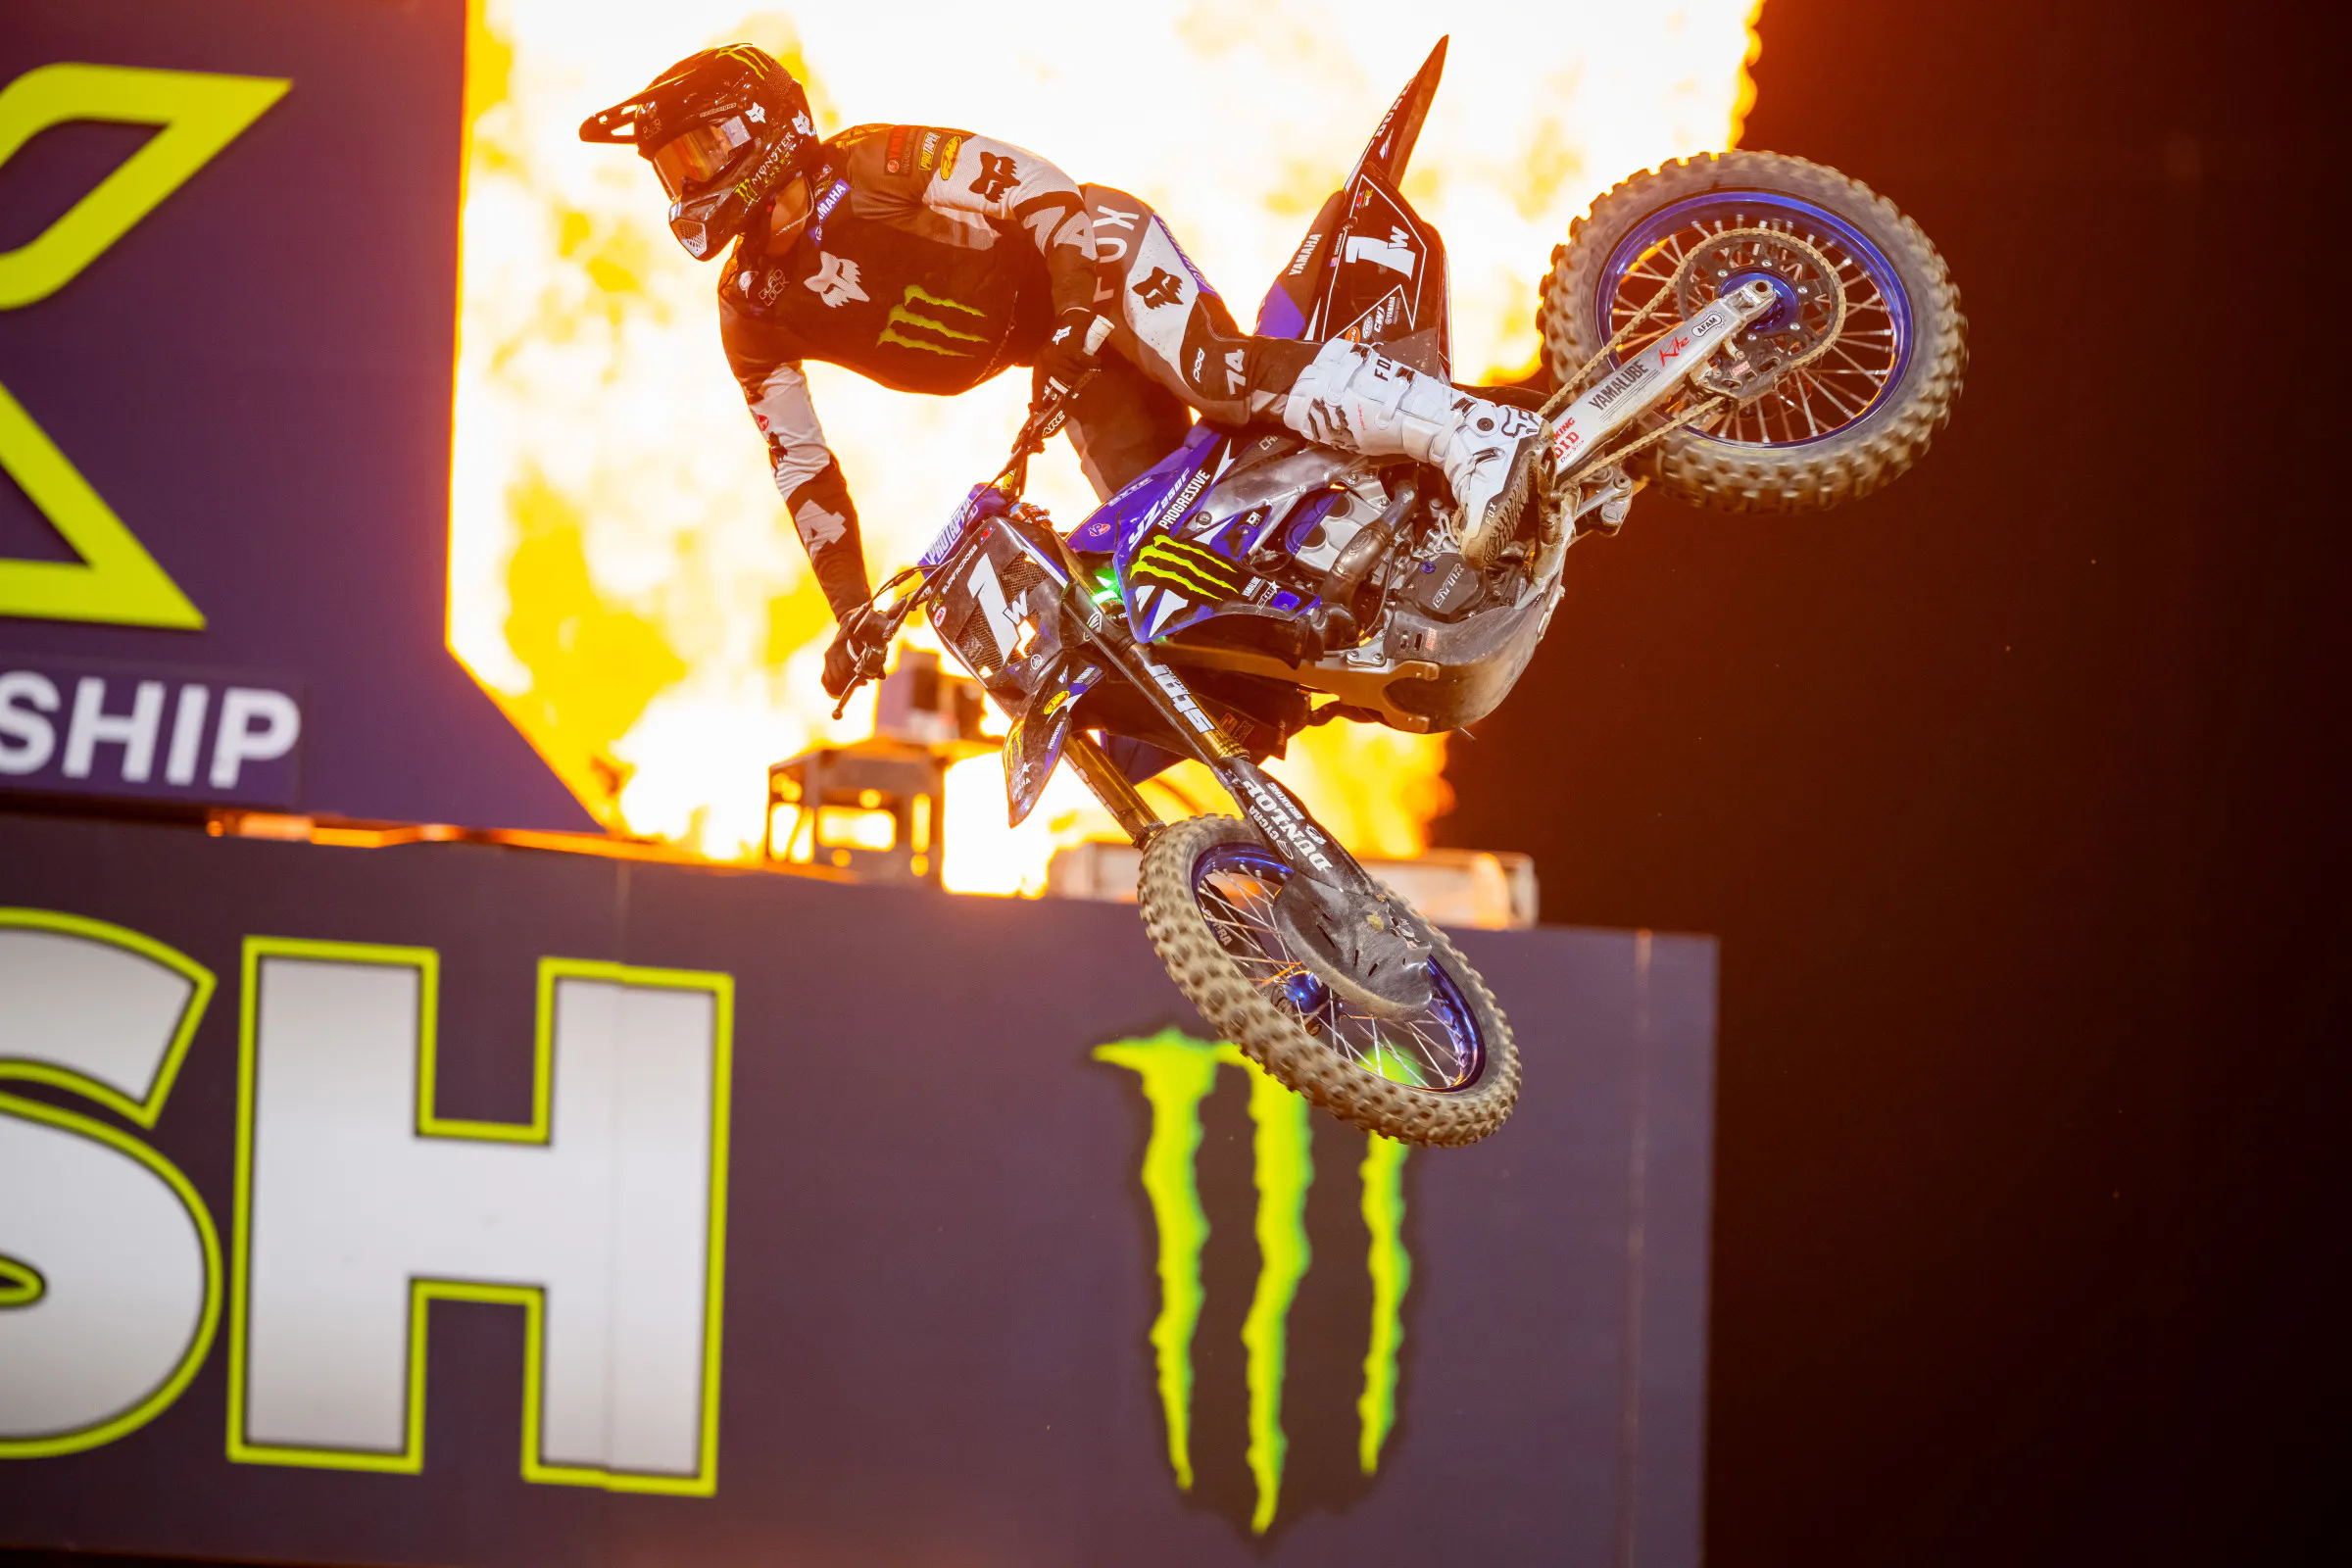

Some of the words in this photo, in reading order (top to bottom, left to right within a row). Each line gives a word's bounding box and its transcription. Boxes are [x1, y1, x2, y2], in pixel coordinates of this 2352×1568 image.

[752, 130, 795, 186] MONSTER
[1289, 233, 1322, 276] YAMAHA
[1696, 316, 1719, 334] AFAM
[1225, 349, 1247, 395] 74
[1374, 357, 1393, 382] FO
[1658, 335, 1690, 368] Kite
[1588, 359, 1650, 413] YAMALUBE
[1041, 410, 1066, 437] ARC
[1552, 416, 1576, 443] KING
[1554, 431, 1582, 461] DID
[1157, 468, 1212, 530] PROGRESSIVE
[1486, 501, 1497, 525] FOX
[926, 498, 978, 565] PROTAPE
[941, 544, 978, 595] SUPERCROSS
[1433, 562, 1465, 610] GYTR
[0, 670, 301, 788] SHIP
[1268, 781, 1304, 820] BRAKING
[1243, 780, 1334, 872] DUNLOP
[1248, 806, 1278, 843] CYCRA
